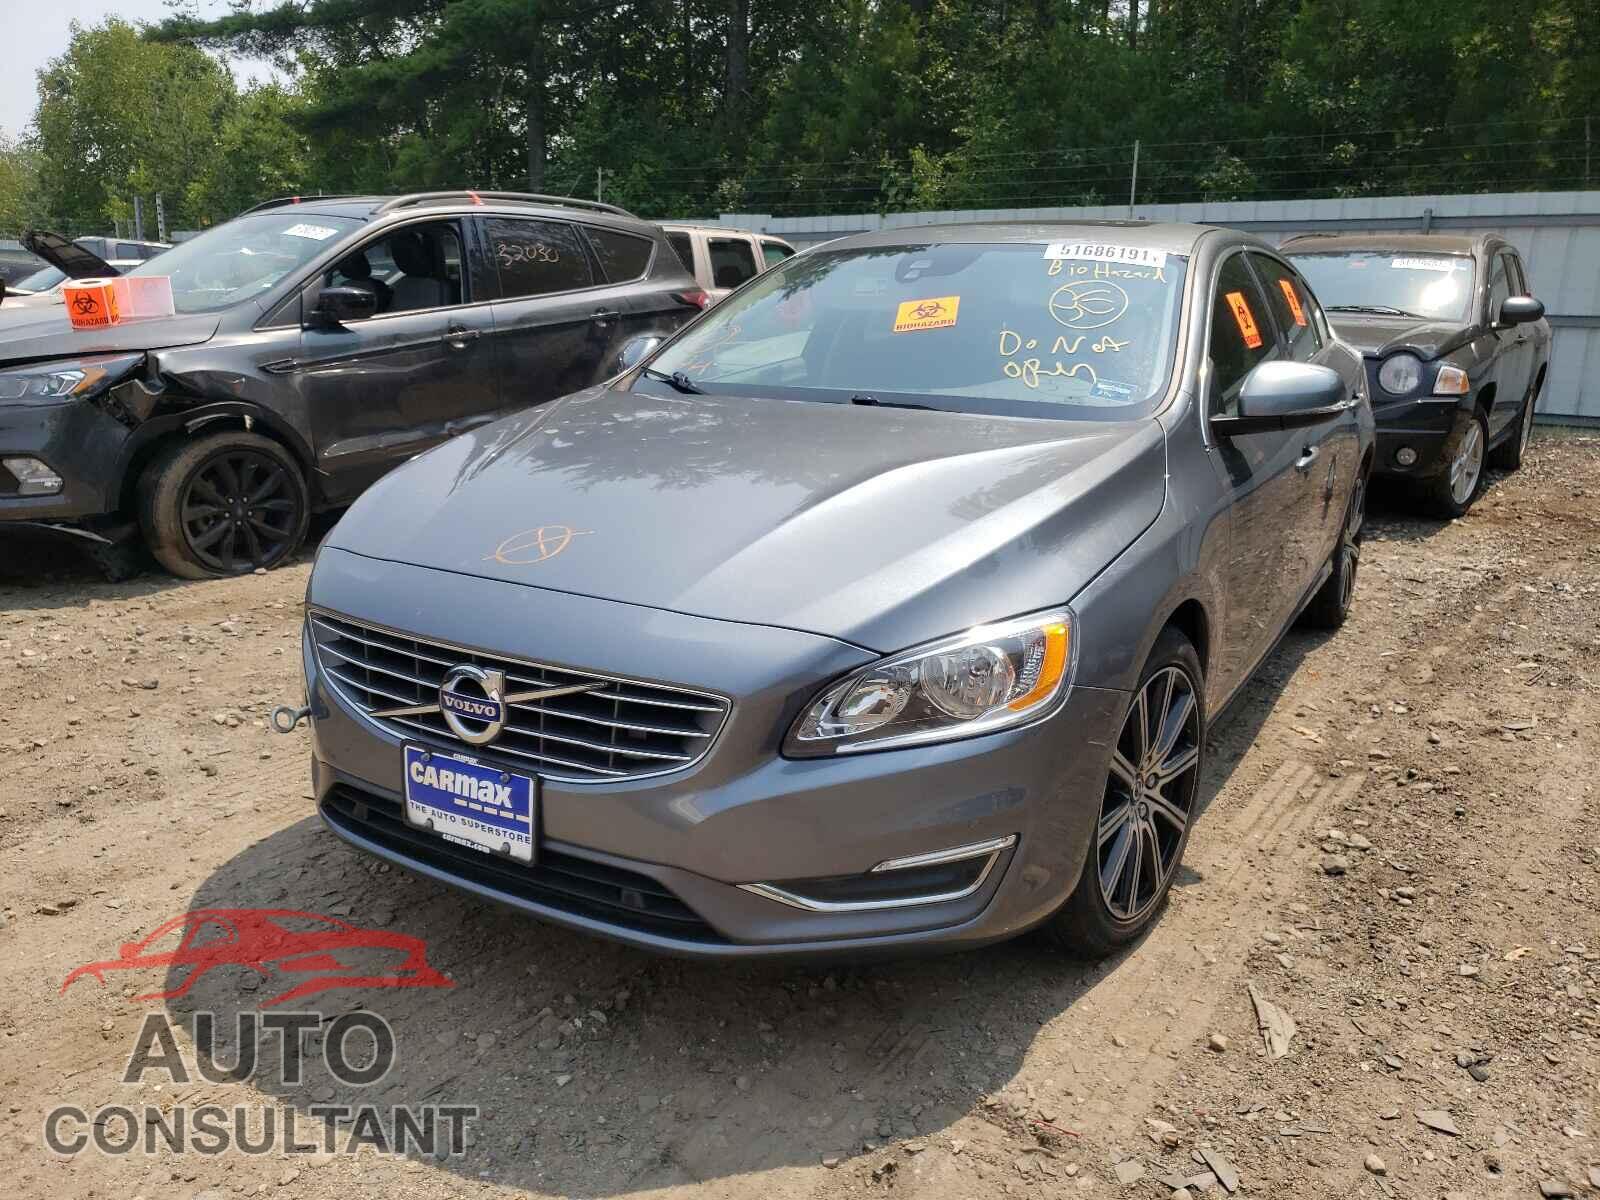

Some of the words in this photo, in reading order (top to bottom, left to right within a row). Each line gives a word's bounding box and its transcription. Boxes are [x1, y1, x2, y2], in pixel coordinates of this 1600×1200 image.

[895, 319, 954, 331] BIOHAZARD
[442, 695, 497, 717] VOLVO
[409, 801, 430, 814] THE
[431, 809, 457, 823] AUTO
[460, 818, 532, 845] SUPERSTORE
